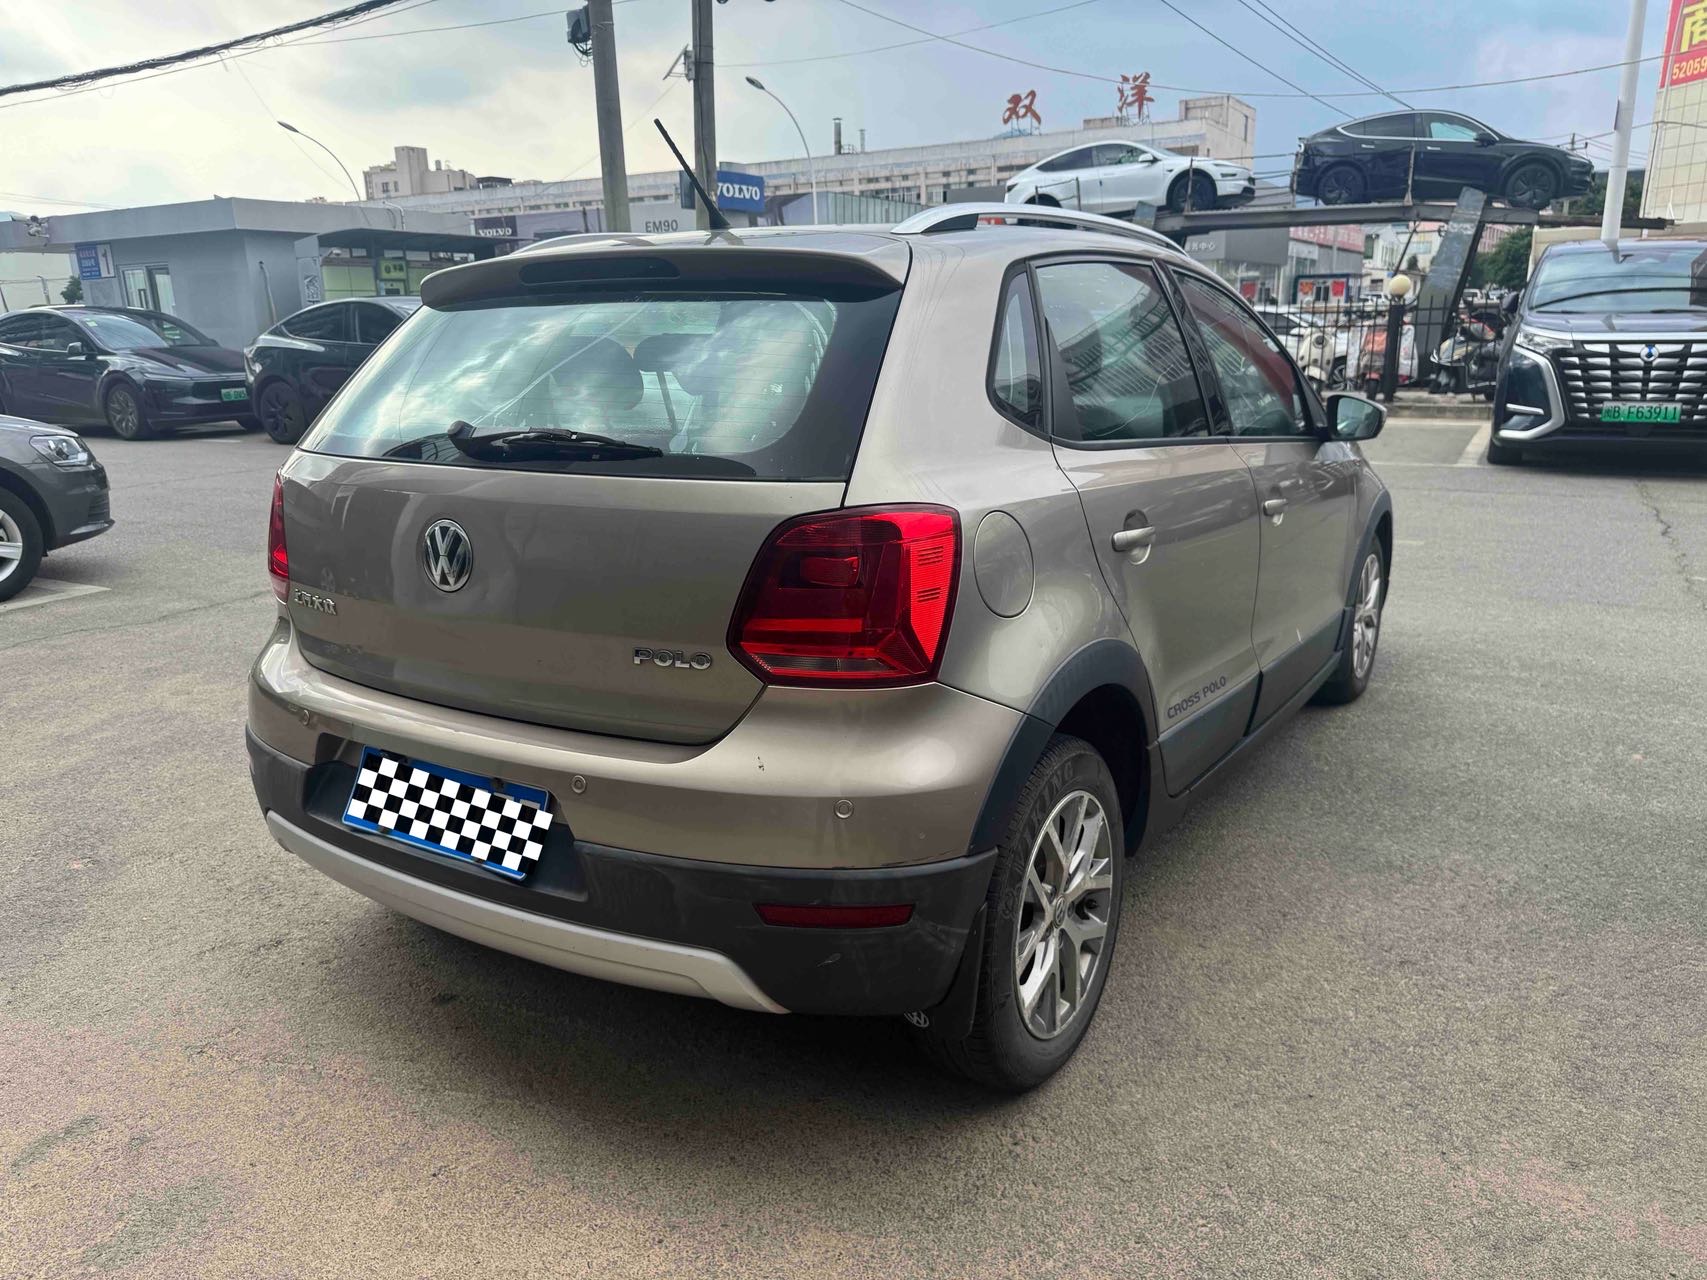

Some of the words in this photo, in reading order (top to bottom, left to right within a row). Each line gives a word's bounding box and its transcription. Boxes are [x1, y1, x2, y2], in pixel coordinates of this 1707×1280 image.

[479, 227, 512, 237] VOLVO
[645, 219, 679, 233] EM90
[633, 647, 712, 670] POLO
[1167, 691, 1201, 719] CROSS
[1202, 676, 1226, 698] POLO
